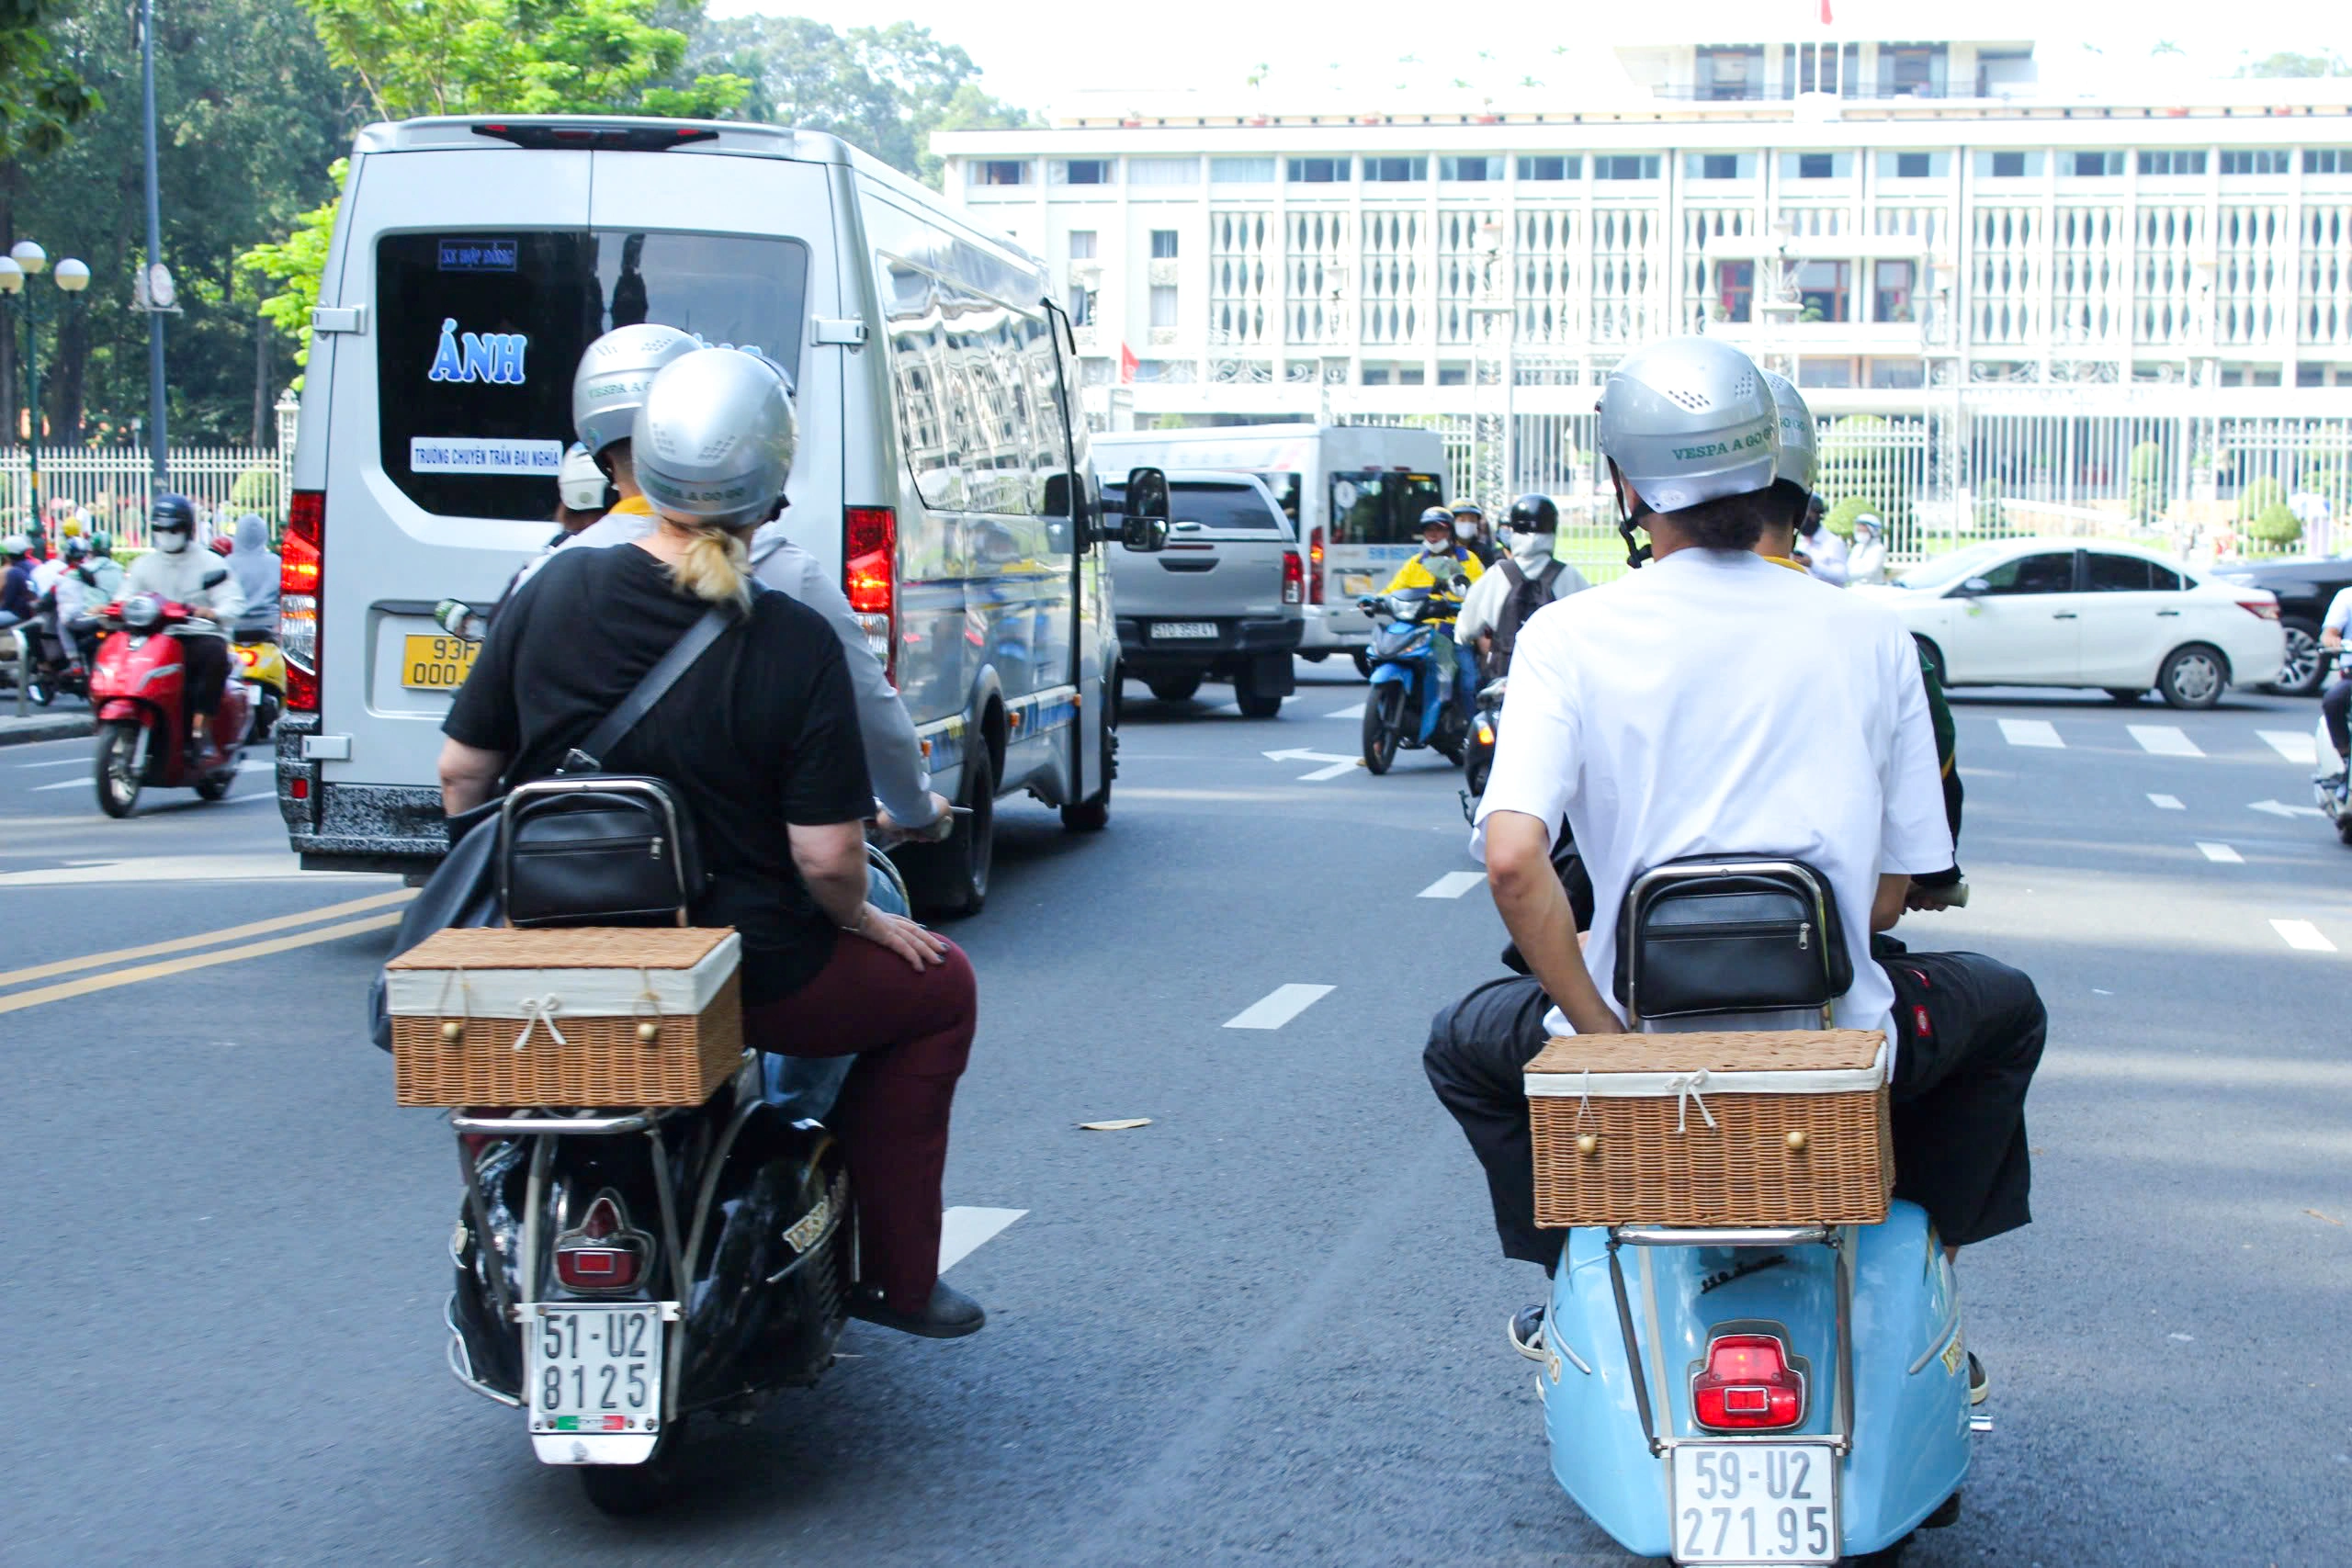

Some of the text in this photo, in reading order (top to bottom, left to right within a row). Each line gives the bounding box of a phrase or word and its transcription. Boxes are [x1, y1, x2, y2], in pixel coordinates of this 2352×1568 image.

[428, 318, 527, 385] ÁNH
[1672, 443, 1729, 460] VESPA
[1733, 438, 1745, 452] A
[1746, 433, 1762, 447] GO
[543, 1363, 647, 1410] 8125
[1695, 1450, 1812, 1500] 59-U2
[1682, 1506, 1828, 1556] 271.95
